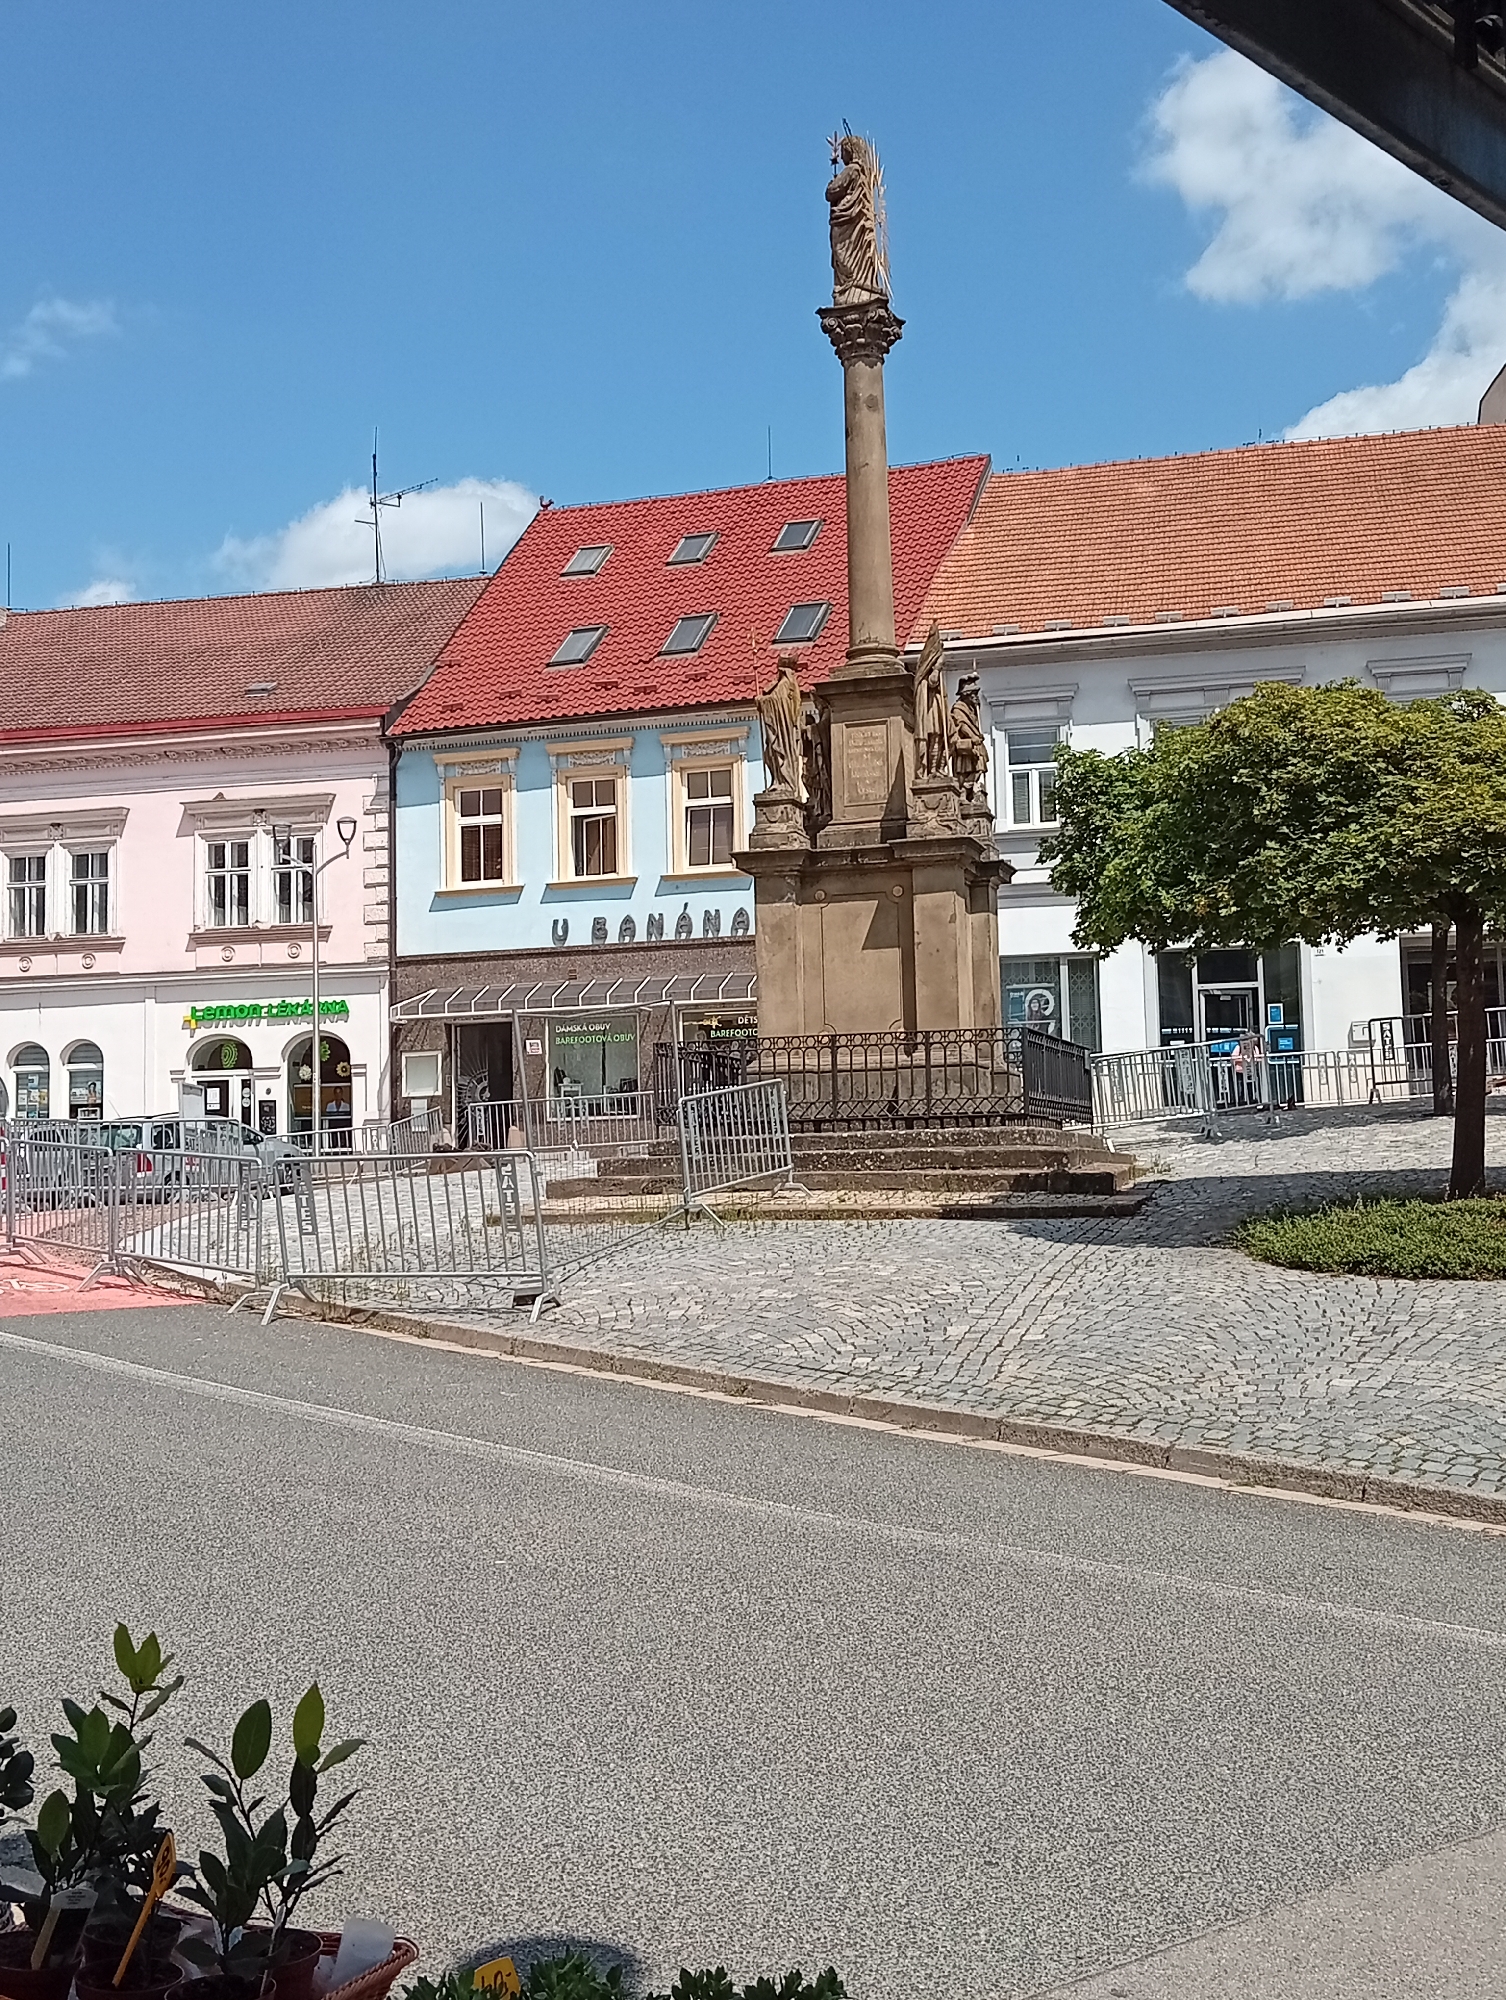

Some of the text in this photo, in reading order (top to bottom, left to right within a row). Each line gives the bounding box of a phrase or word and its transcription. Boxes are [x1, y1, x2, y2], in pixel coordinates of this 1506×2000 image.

[552, 901, 750, 947] U BANÁNA
[190, 1003, 262, 1020] Lemon
[555, 1022, 612, 1033] DÁMSKÁ OBUV
[555, 1033, 636, 1045] BAREFOOTOVÁ OBUV
